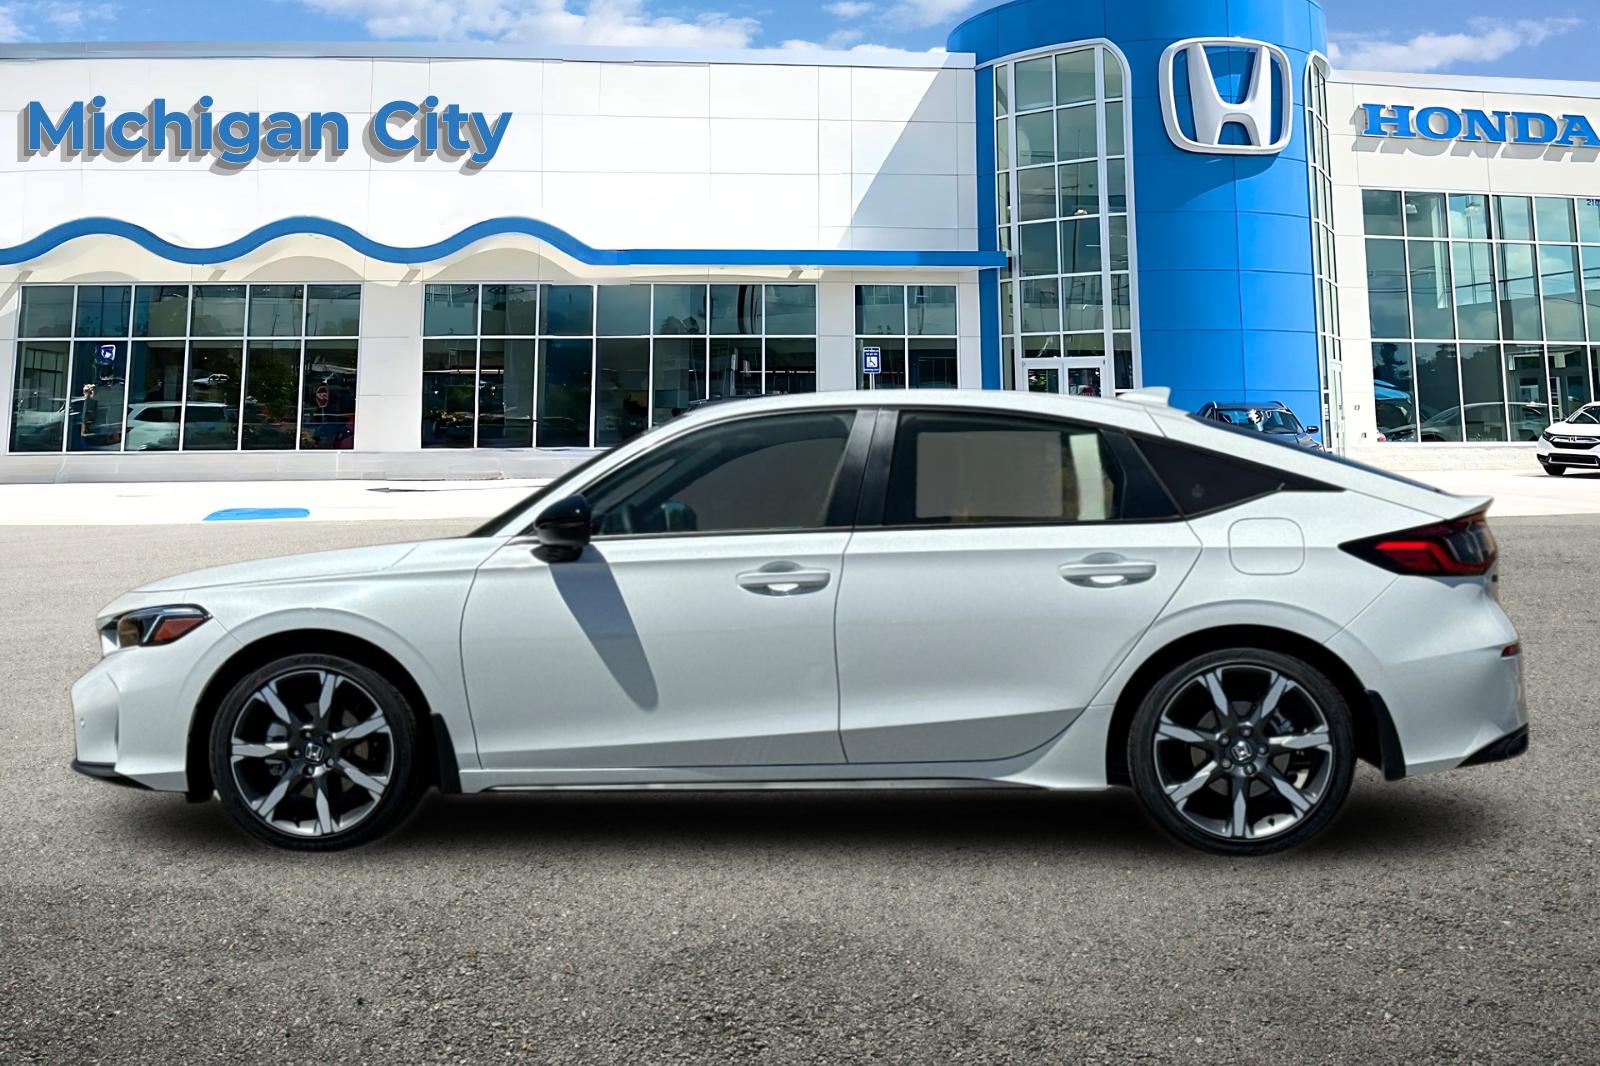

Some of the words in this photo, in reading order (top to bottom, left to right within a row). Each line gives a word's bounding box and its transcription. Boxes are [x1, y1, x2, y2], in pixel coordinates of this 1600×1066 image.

[28, 95, 350, 164] Michigan
[373, 95, 513, 164] City
[1361, 103, 1600, 148] HONDA
